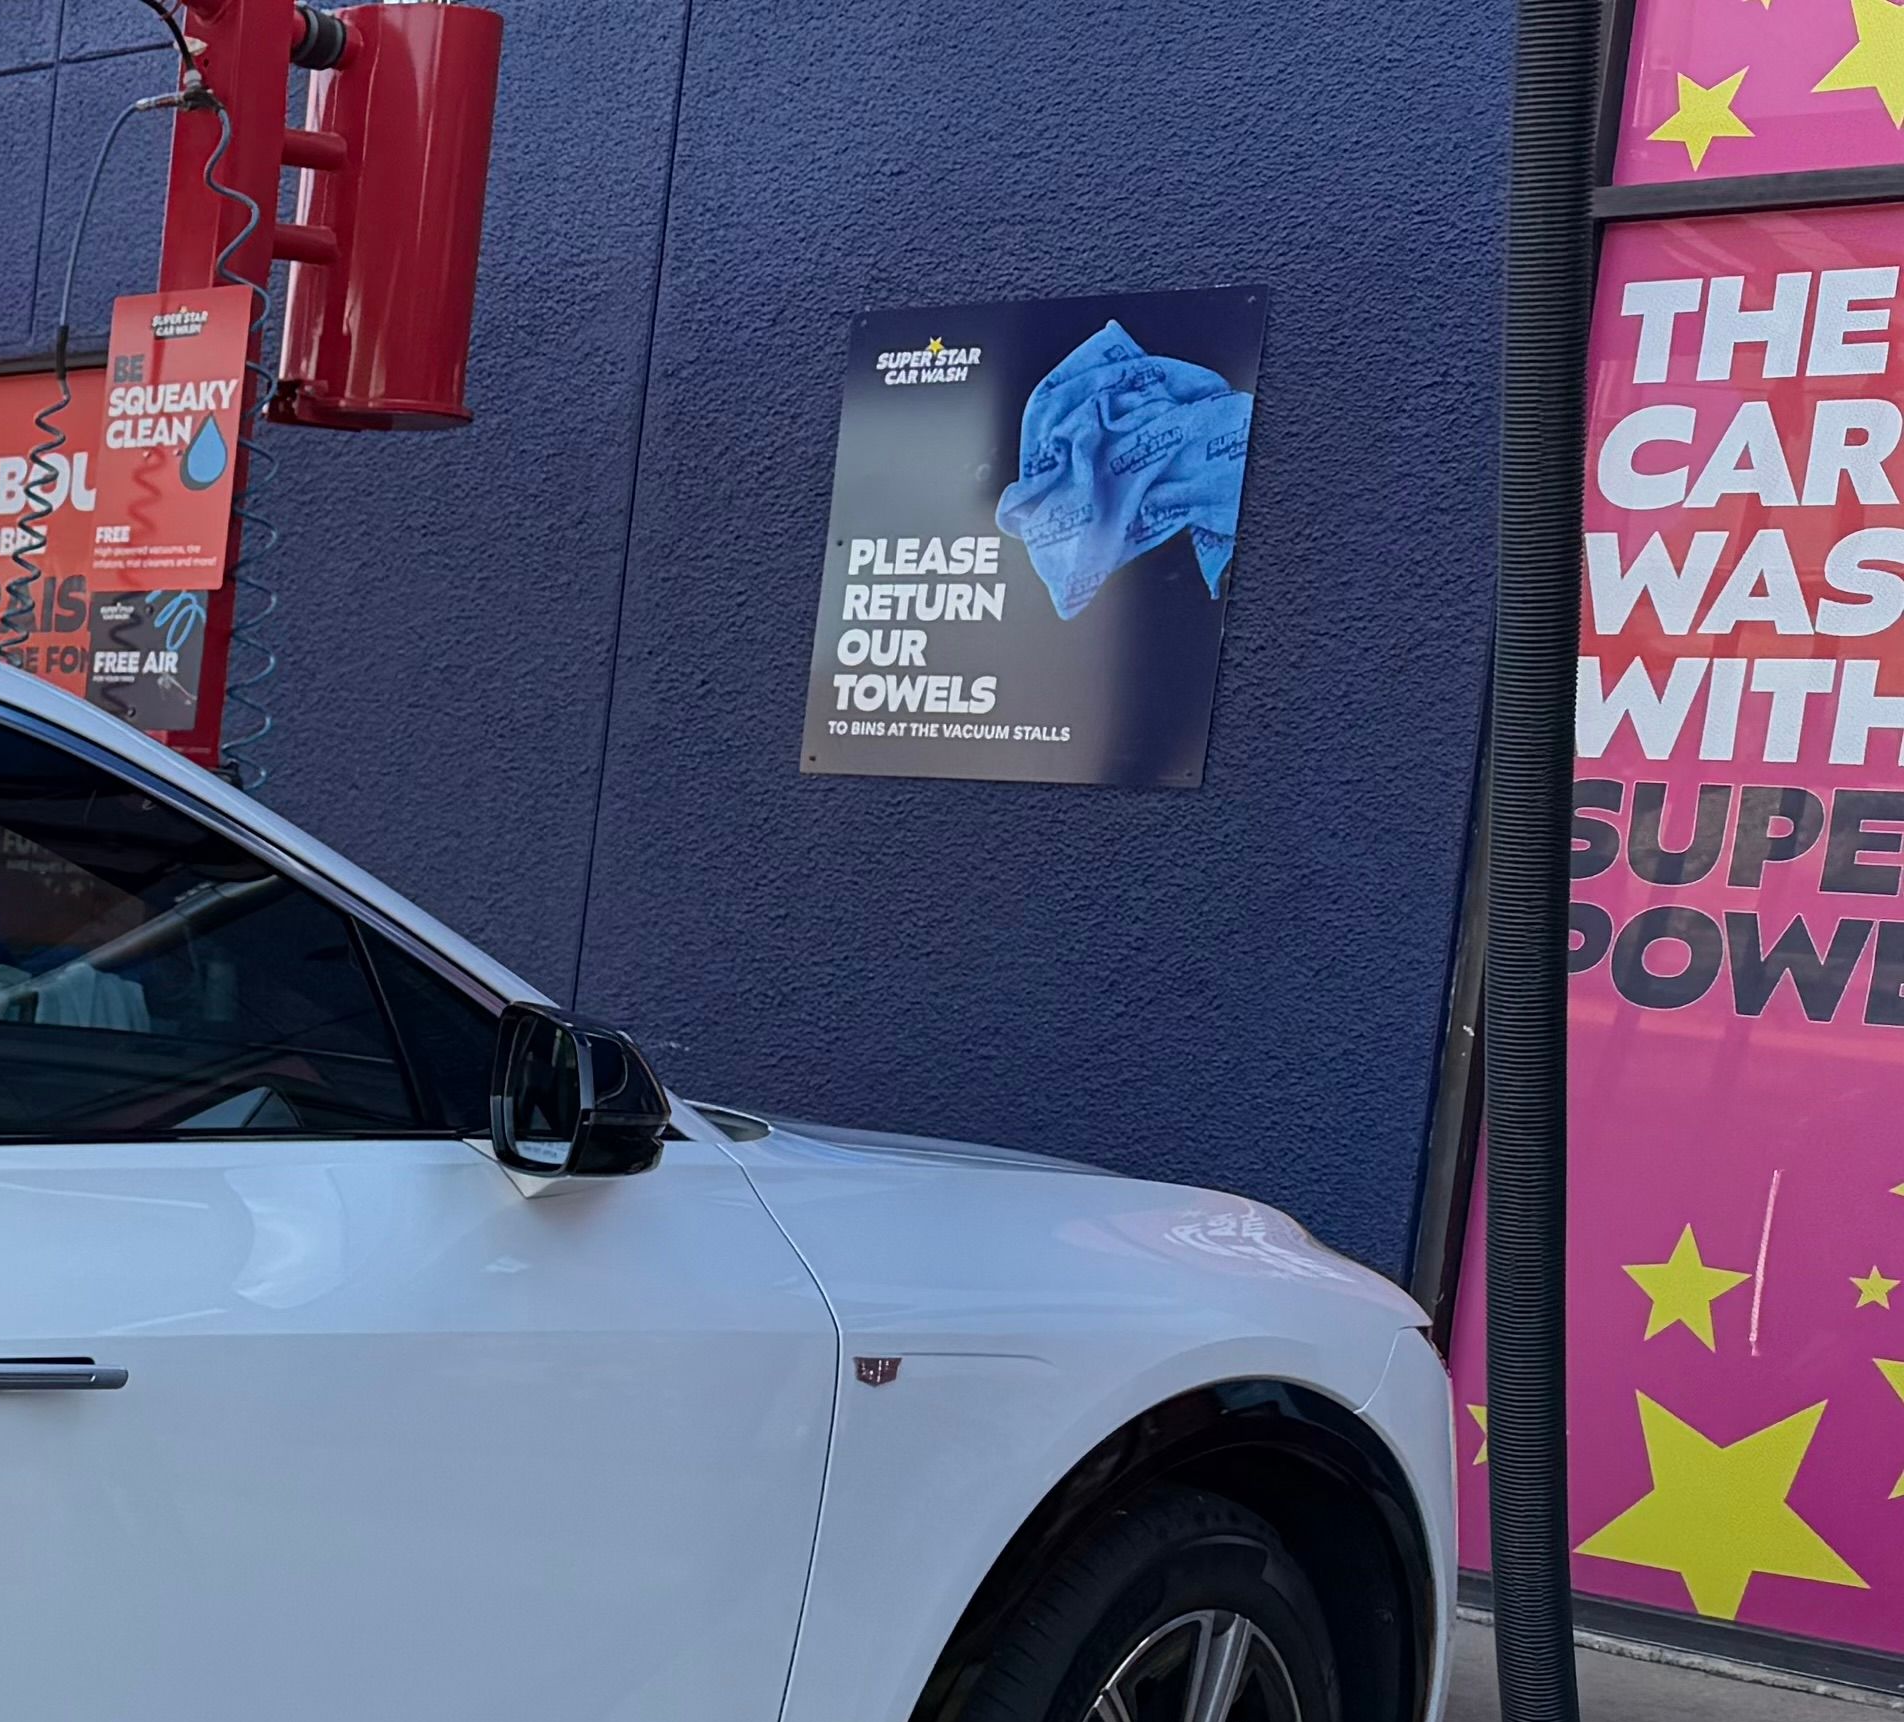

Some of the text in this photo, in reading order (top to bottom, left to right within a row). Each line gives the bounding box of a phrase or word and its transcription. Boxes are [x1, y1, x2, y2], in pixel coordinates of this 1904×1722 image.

[1621, 266, 1900, 384] THE
[114, 354, 145, 383] BE
[876, 347, 982, 370] SUPER STAR
[884, 366, 968, 385] CAR WASH
[108, 379, 239, 417] SQUEAKY
[106, 415, 194, 449] CLEAN
[1597, 399, 1904, 510] CAR
[95, 525, 131, 544] FREE
[848, 537, 1000, 575] PLEASE
[842, 582, 1006, 621] RETURN
[93, 651, 179, 674] FREE AIR
[837, 628, 927, 667] OUR
[833, 674, 997, 714] TOWELS
[1575, 656, 1904, 766] WITH
[828, 720, 1071, 742] TO BINS AT THE VACUUM STALLS
